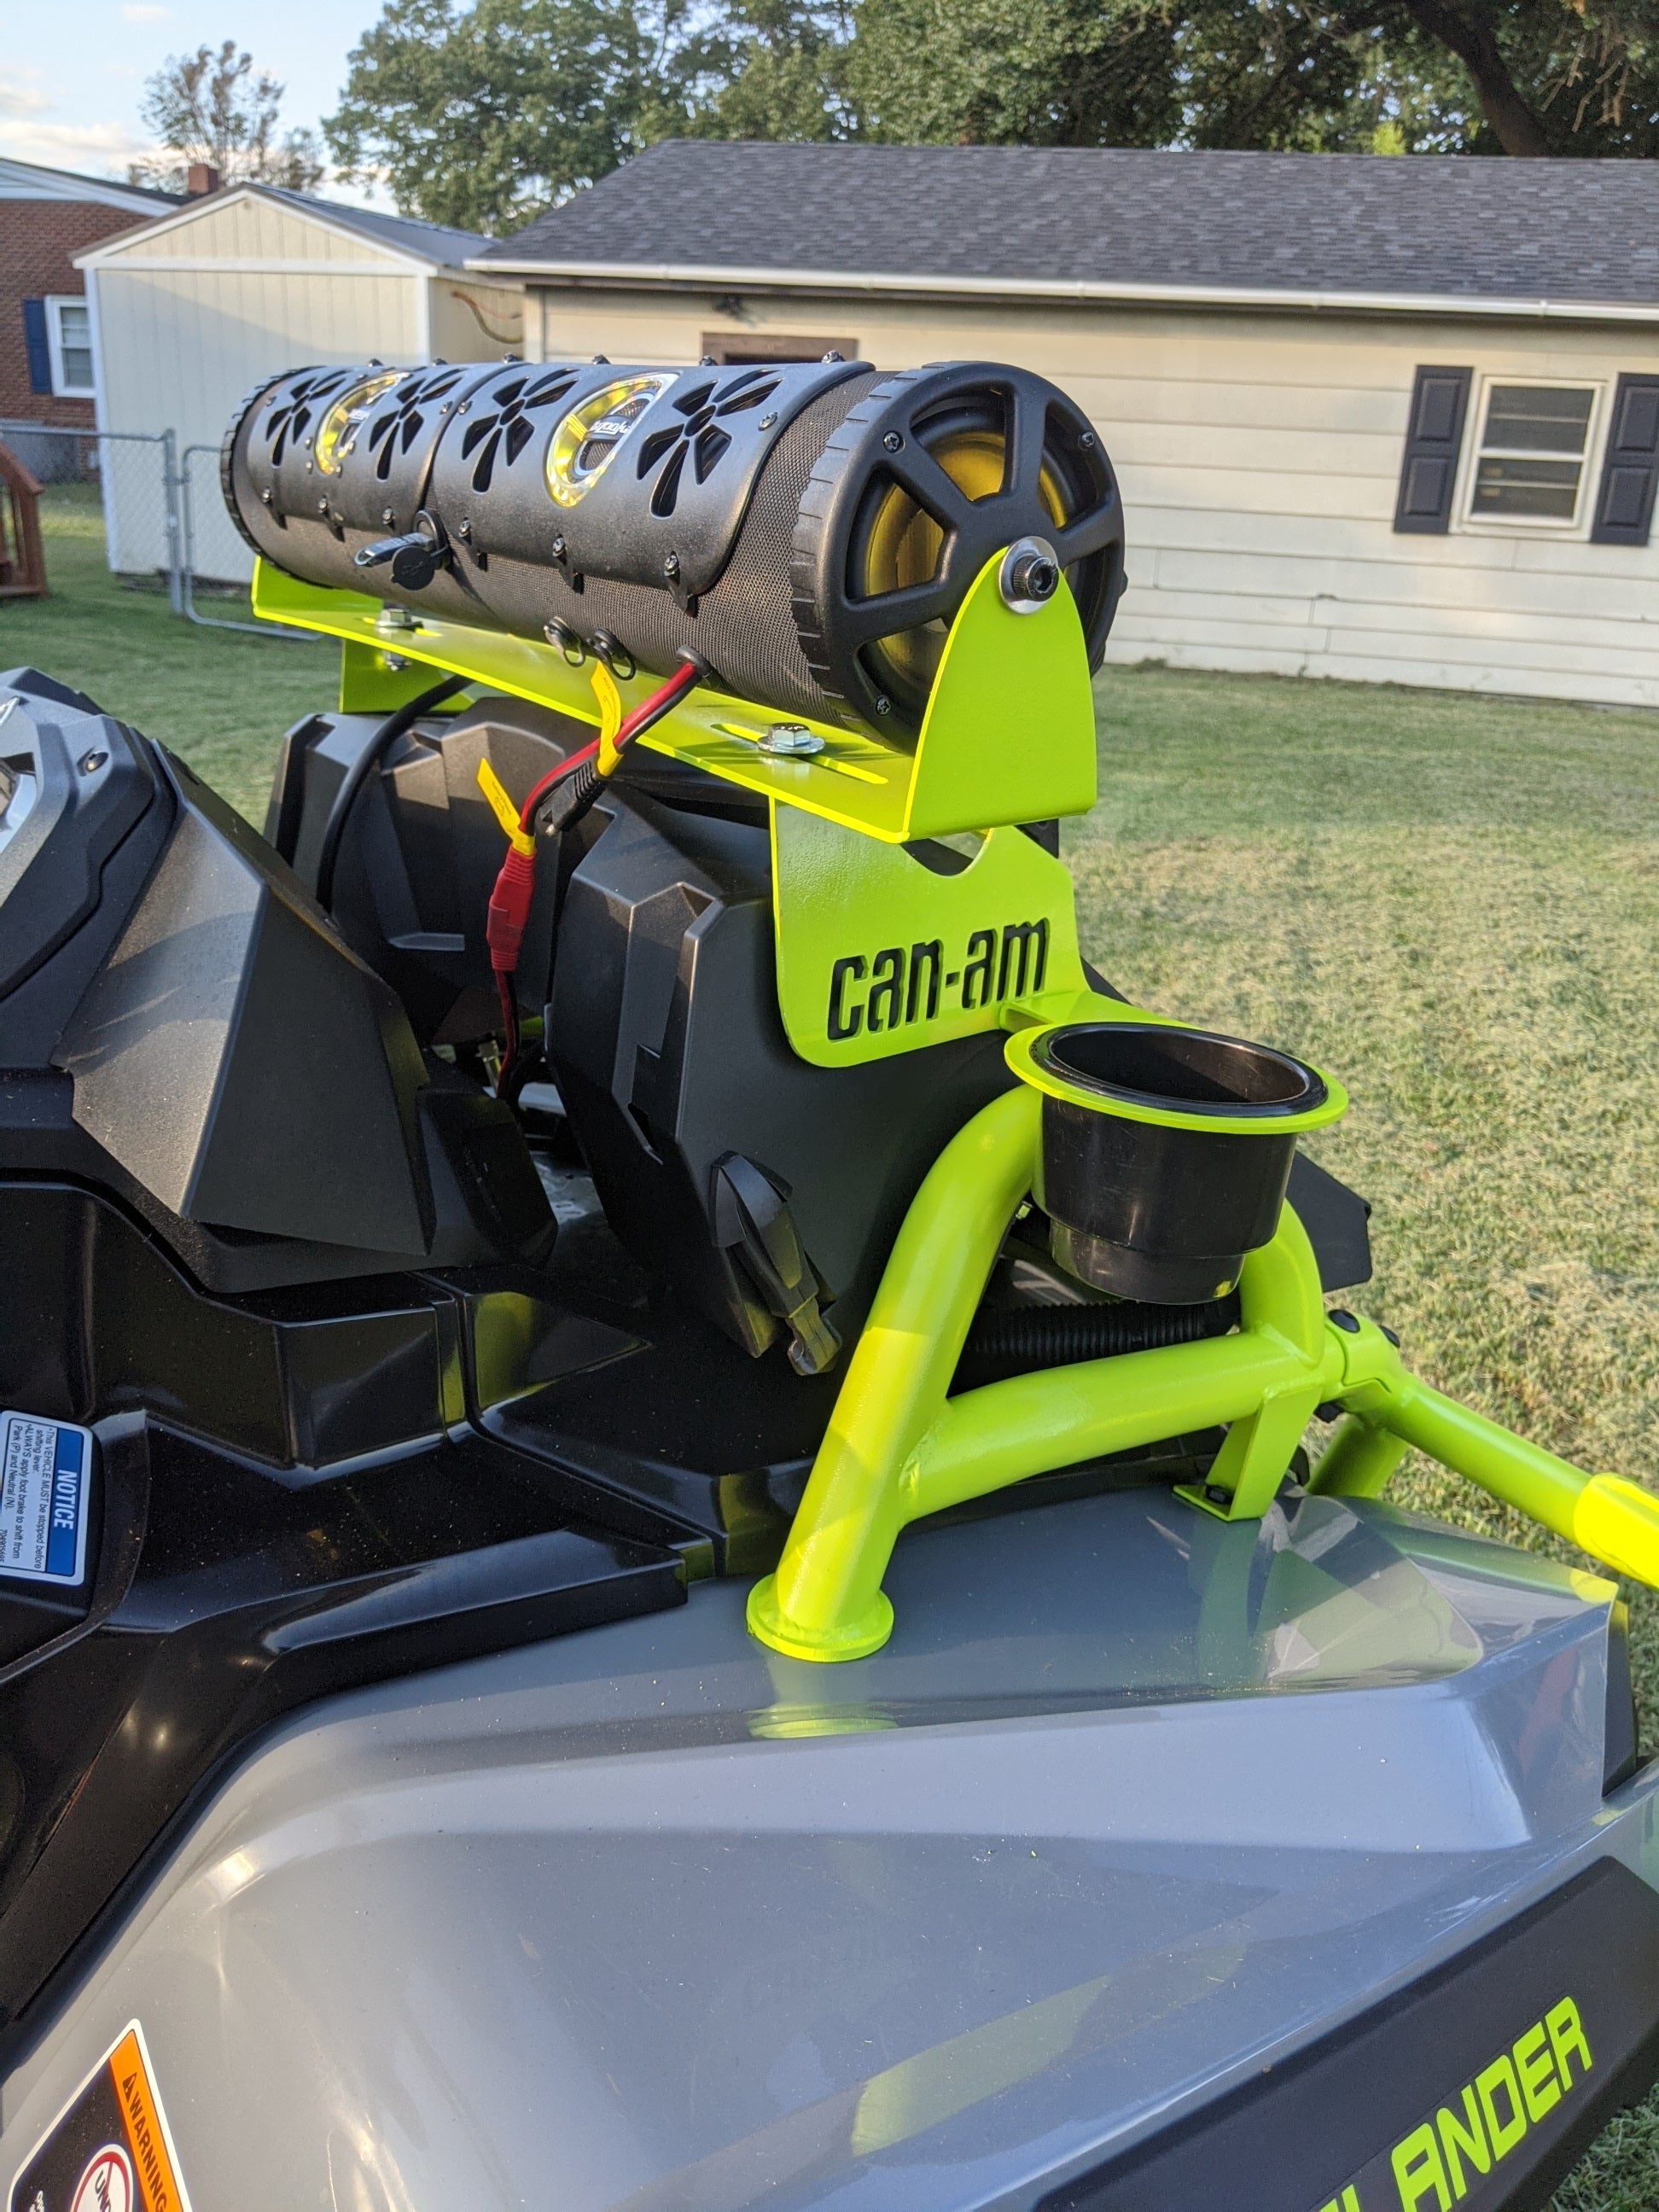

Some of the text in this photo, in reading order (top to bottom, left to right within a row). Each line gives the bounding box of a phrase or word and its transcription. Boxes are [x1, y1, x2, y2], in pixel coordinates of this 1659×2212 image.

[826, 917, 1051, 1044] can-am
[14, 1424, 23, 1441] Park
[32, 1429, 44, 1453] shifting
[10, 1442, 21, 1453] (P)
[19, 1458, 29, 1478] apply
[8, 1469, 18, 1495] Neutral
[19, 1479, 29, 1493] foot
[17, 1493, 27, 1515] brake
[34, 1430, 55, 1569] This VEHICLE MUST be stopped before
[54, 1470, 77, 1530] NOTICE
[14, 1524, 24, 1540] shift
[12, 1541, 23, 1559] from
[1318, 1996, 1593, 2212] ANDER
[129, 2089, 167, 2212] WARNING
